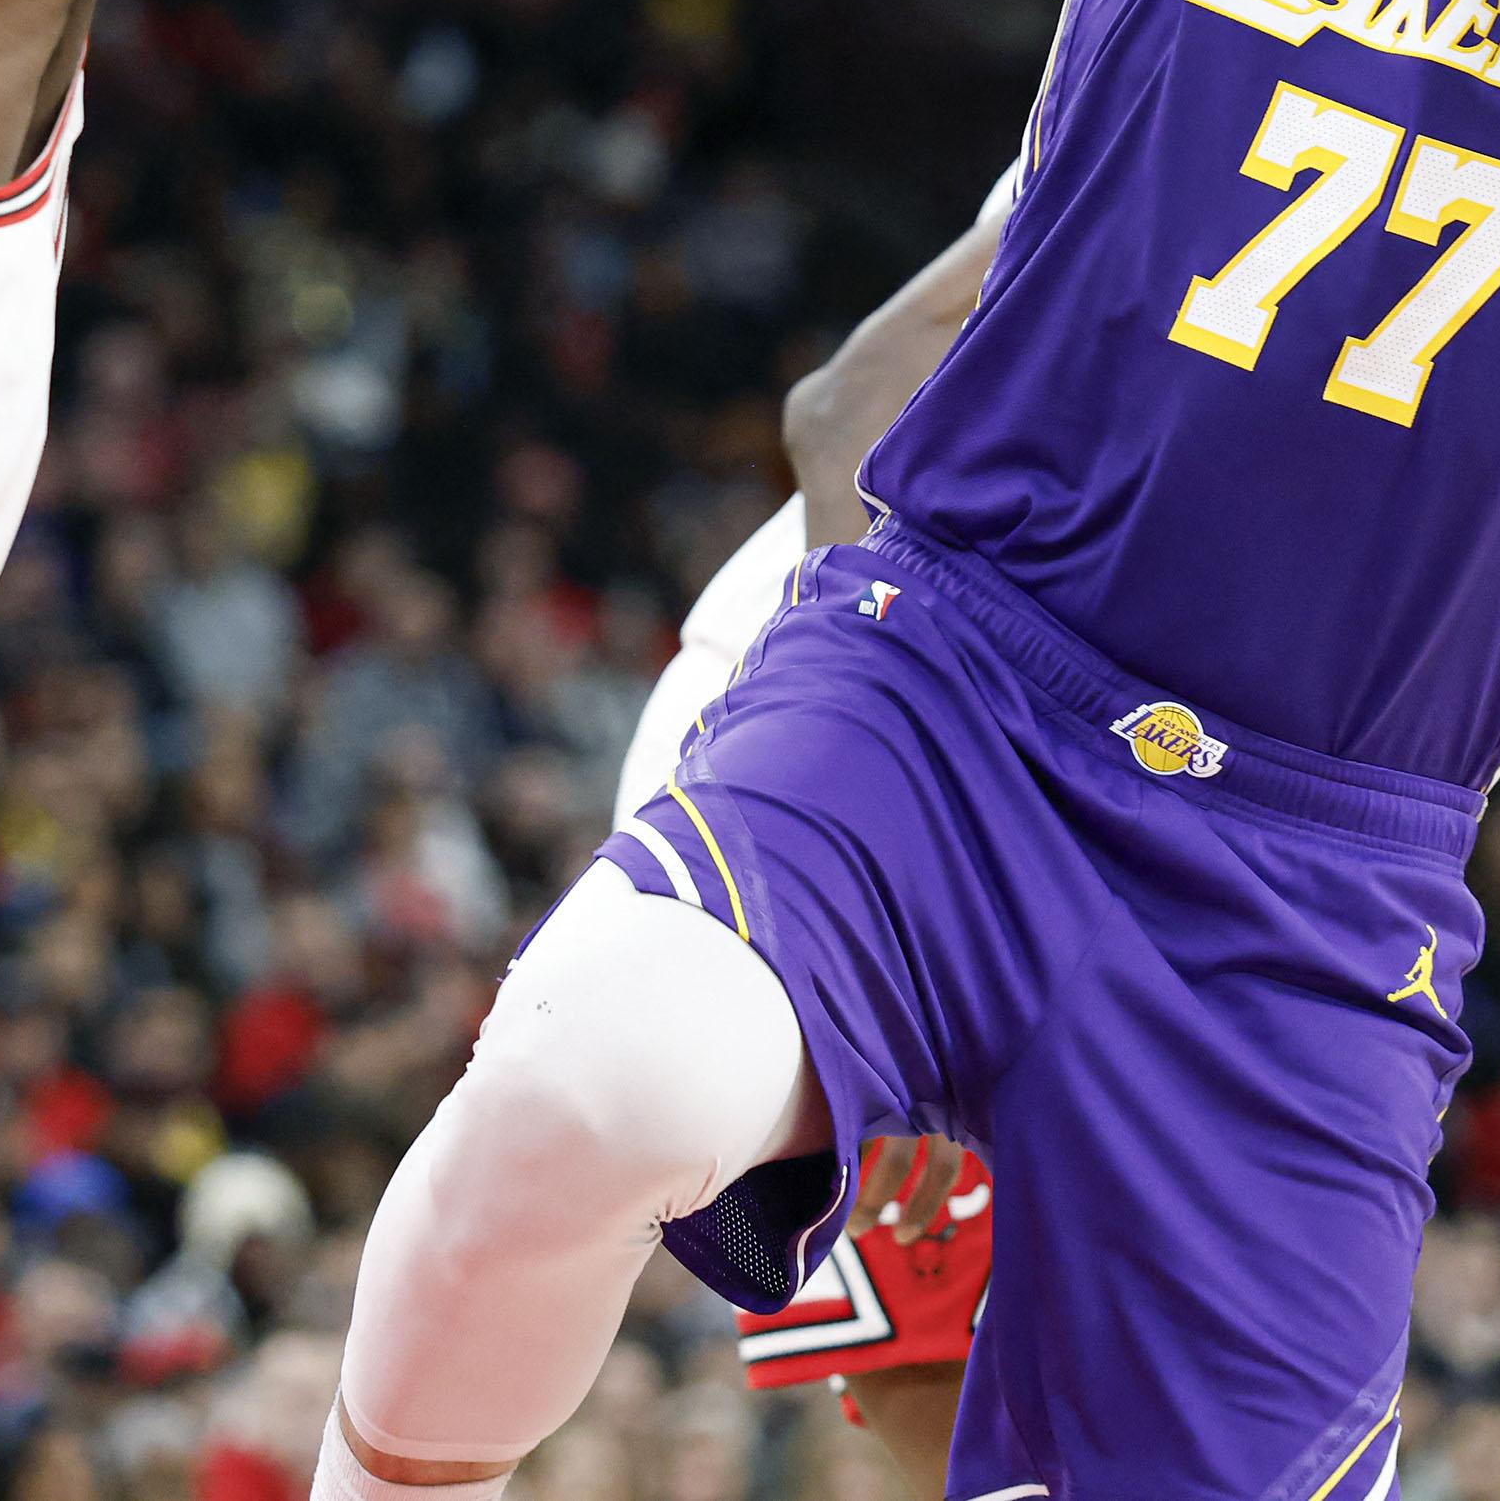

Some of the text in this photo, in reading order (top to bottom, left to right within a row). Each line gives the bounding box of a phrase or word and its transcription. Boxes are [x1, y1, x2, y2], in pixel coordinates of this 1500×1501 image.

[1122, 710, 1218, 775] LAKERS
[1158, 717, 1221, 751] LOS ANGELES
